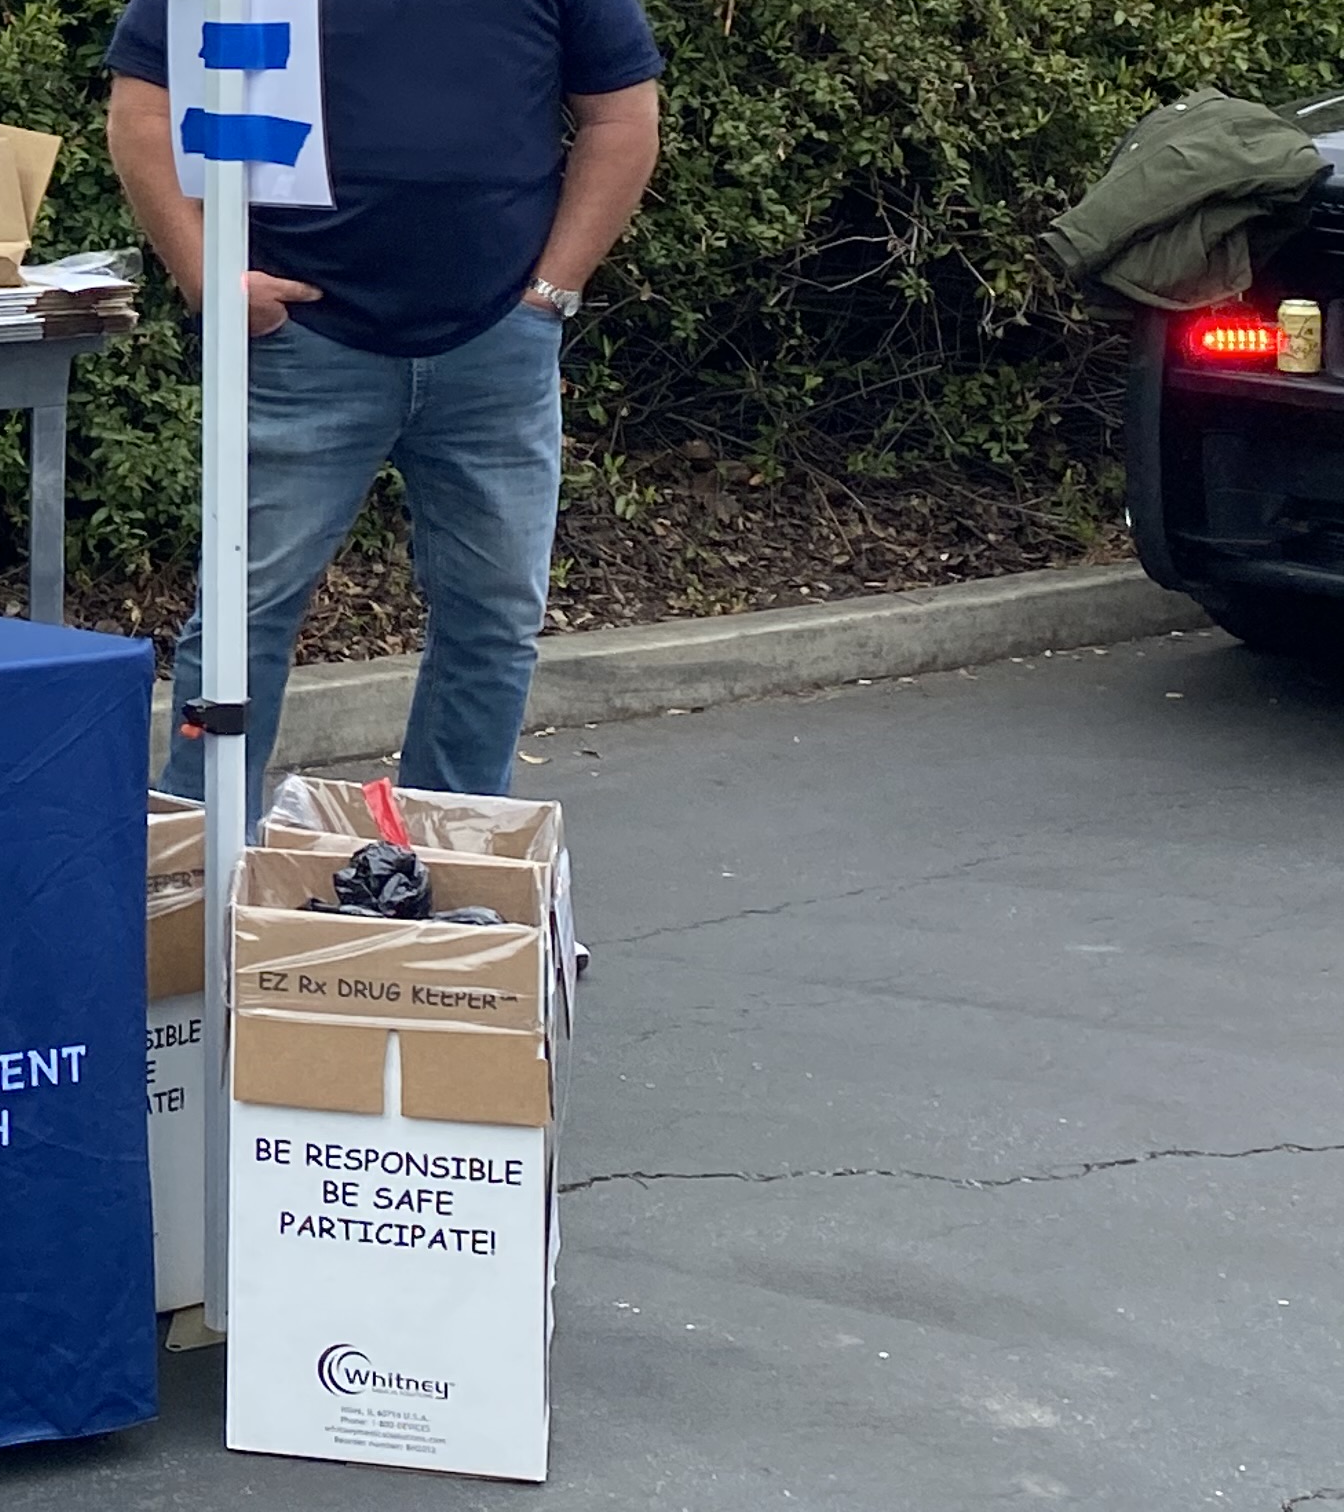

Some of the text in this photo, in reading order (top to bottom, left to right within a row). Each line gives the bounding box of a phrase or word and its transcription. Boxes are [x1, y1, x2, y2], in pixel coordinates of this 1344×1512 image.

[259, 971, 288, 992] EZ
[299, 974, 327, 995] Rx
[338, 978, 401, 1002] DRUG
[256, 1138, 524, 1185] BE RESPONSIBLE
[323, 1180, 454, 1216] BE SAFE
[280, 1211, 497, 1256] PARTICIPATE!
